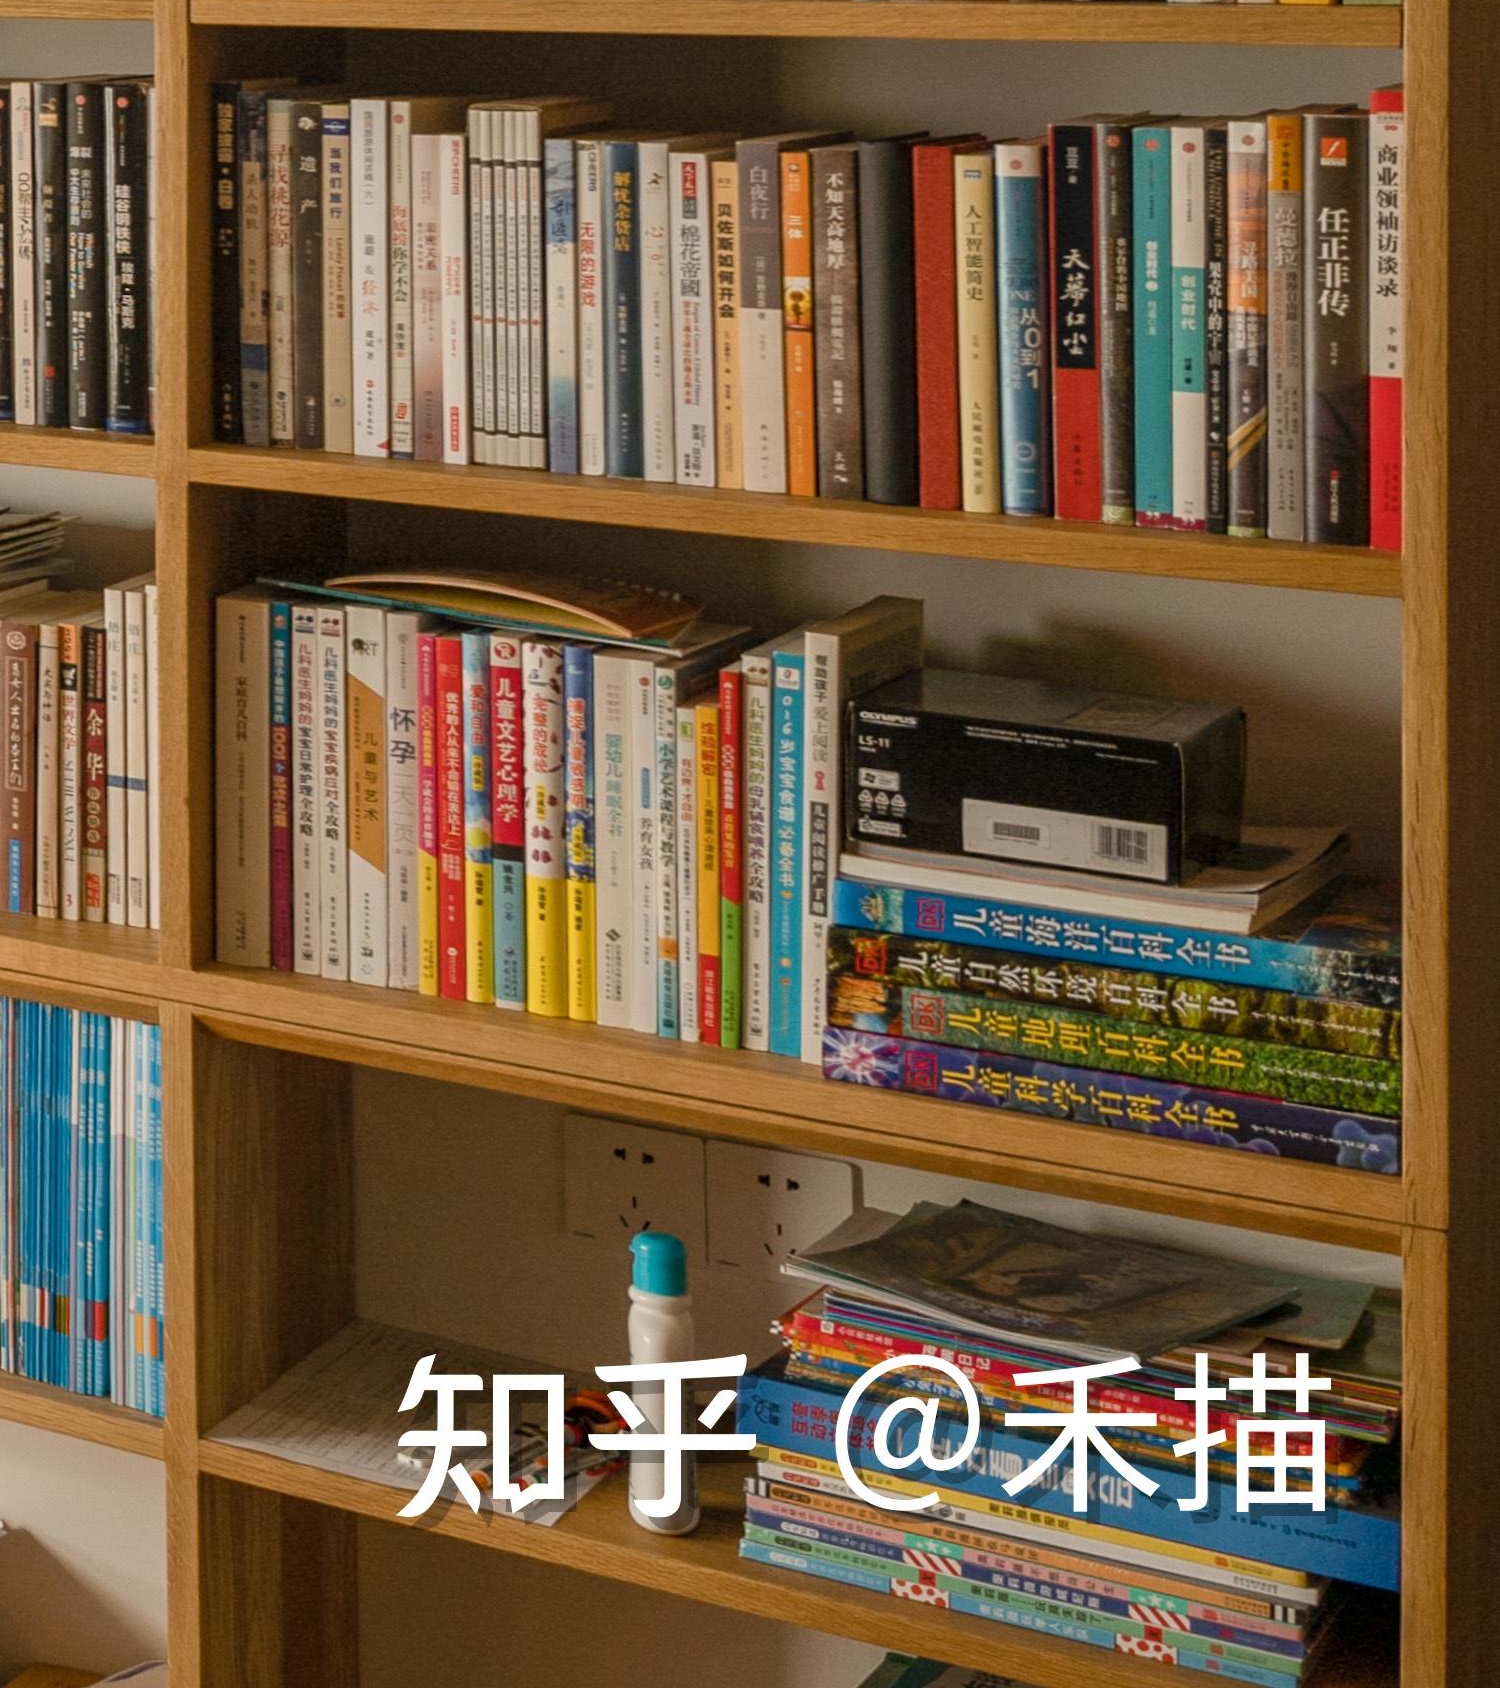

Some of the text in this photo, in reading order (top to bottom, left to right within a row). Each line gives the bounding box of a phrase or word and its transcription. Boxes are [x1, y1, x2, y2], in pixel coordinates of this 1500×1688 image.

[270, 144, 290, 247] 寻找桃花源
[299, 156, 317, 214] 遗产
[749, 166, 769, 220] 白夜行
[824, 173, 847, 270] 不知天高地厚
[1375, 144, 1399, 298] 商业领袖访谈录
[580, 222, 597, 307] 无限的游戏
[680, 224, 700, 298] 棉花帝國
[718, 204, 735, 319] 贝佐斯如何开会
[965, 205, 984, 301] 人工智能简史
[1317, 207, 1350, 318] 任正非传
[389, 708, 416, 765] 怀孕
[495, 678, 519, 822] 儿童文艺心理学
[859, 710, 918, 726] OLYMPUS
[859, 734, 890, 748] LS-11
[952, 908, 1252, 966] 儿童海洋百科全书
[948, 1010, 1247, 1070] 儿童地理百科全书
[942, 1064, 1240, 1131] 儿童科学百科全书
